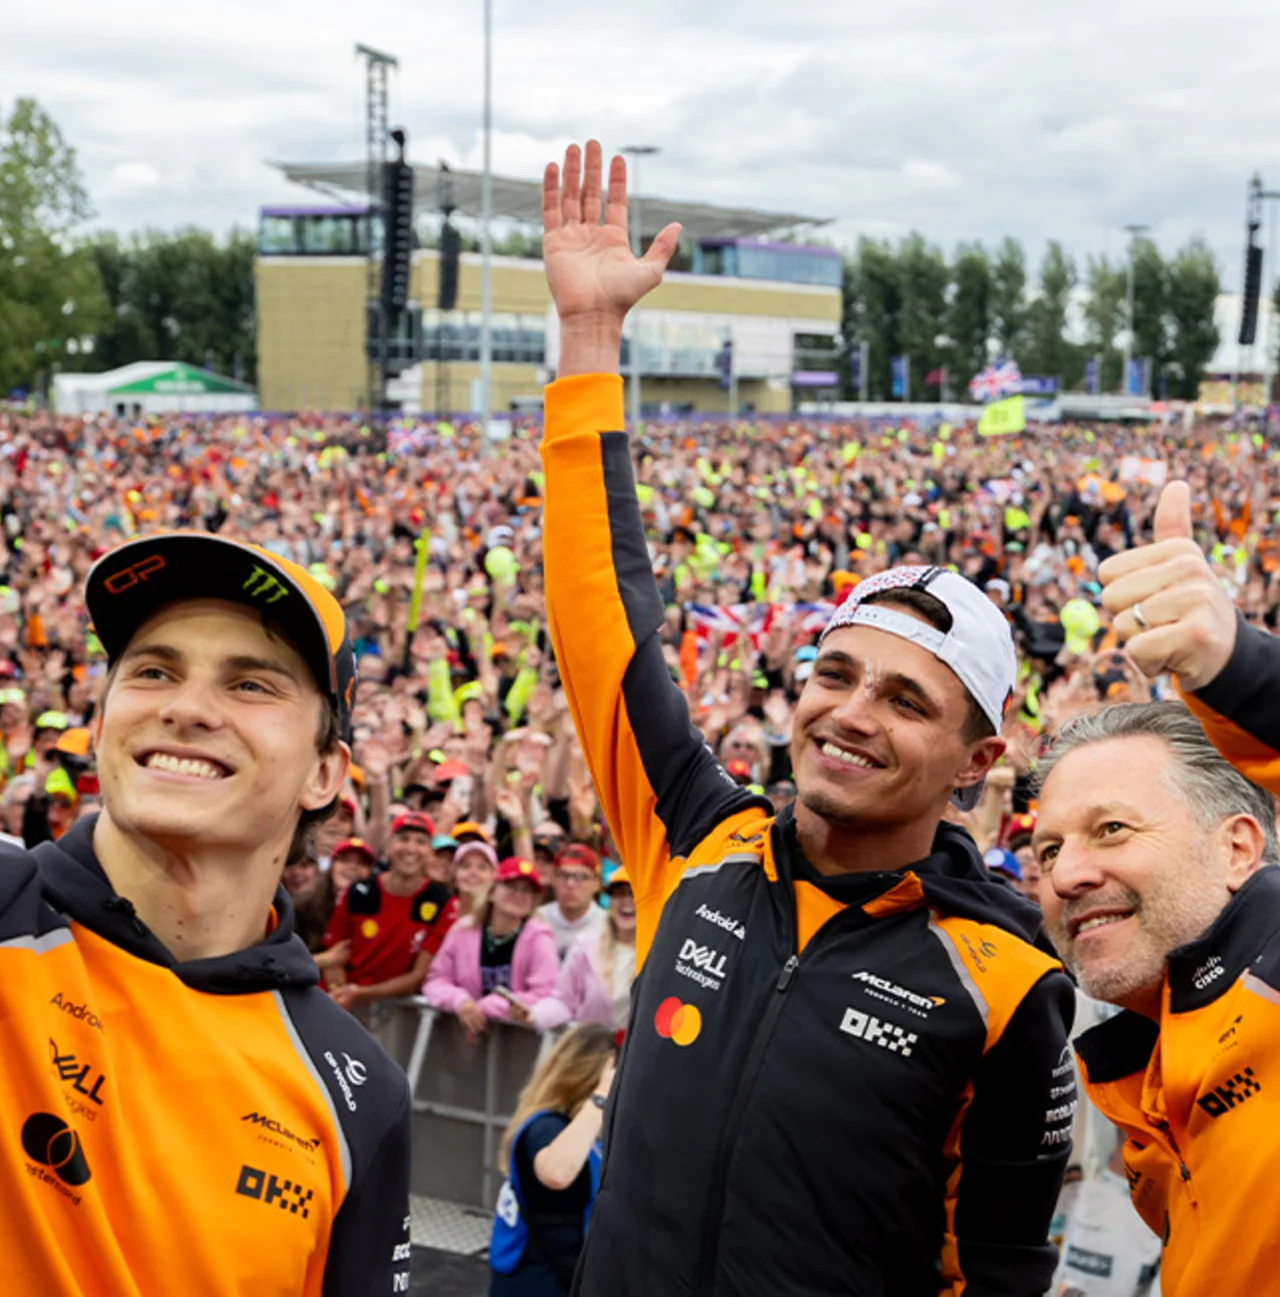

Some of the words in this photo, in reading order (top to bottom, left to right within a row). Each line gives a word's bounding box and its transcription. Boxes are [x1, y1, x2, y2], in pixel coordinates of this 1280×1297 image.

[695, 903, 739, 931] Android
[679, 938, 727, 978] DELL
[50, 991, 103, 1030] Andro
[852, 971, 934, 1009] McLaren
[839, 1007, 918, 1057] OKX
[333, 1067, 357, 1112] WORLD
[1196, 1067, 1261, 1118] OKX
[235, 1164, 314, 1219] OKX
